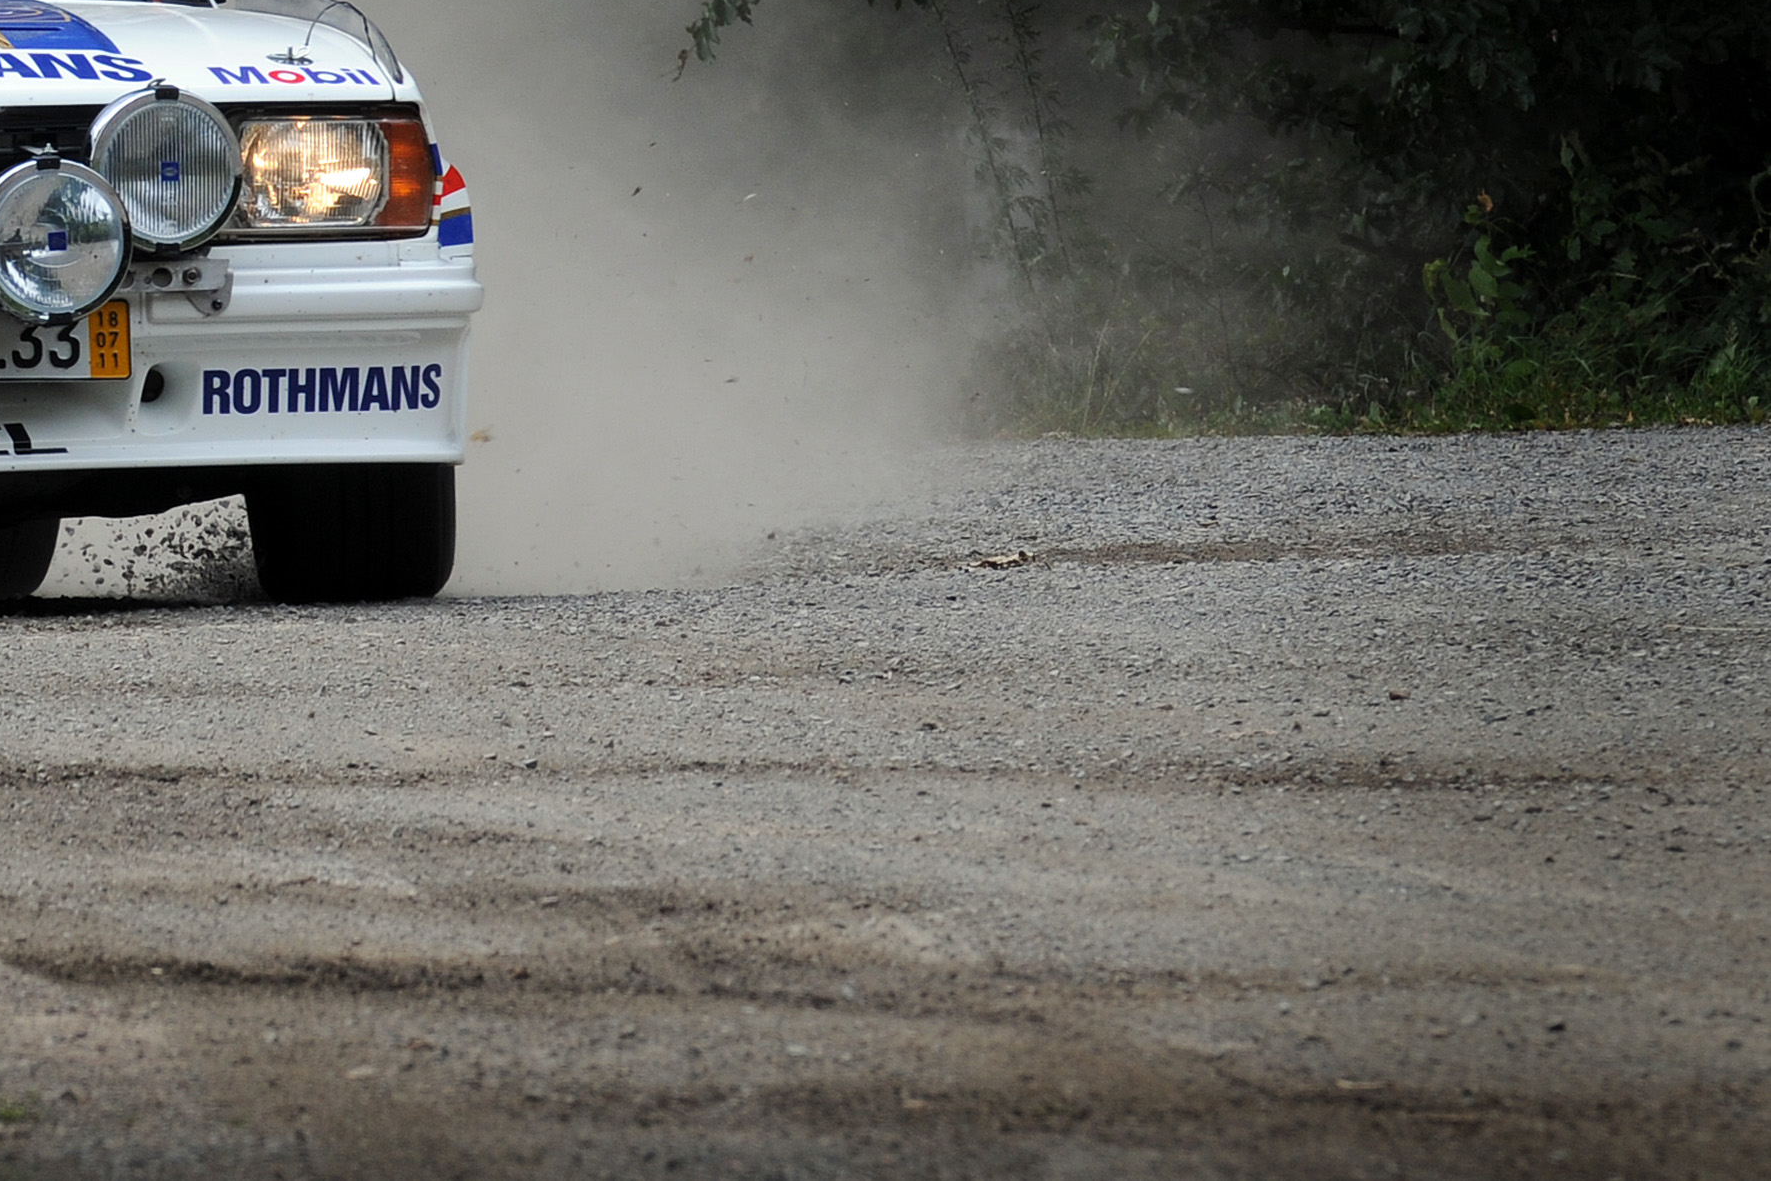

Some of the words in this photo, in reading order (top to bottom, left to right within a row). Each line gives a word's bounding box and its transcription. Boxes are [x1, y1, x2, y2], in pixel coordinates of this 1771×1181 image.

[208, 66, 381, 86] Mobil
[97, 311, 119, 327] 18
[96, 332, 118, 348] 07
[98, 352, 120, 369] 11
[203, 363, 442, 415] ROTHMANS
